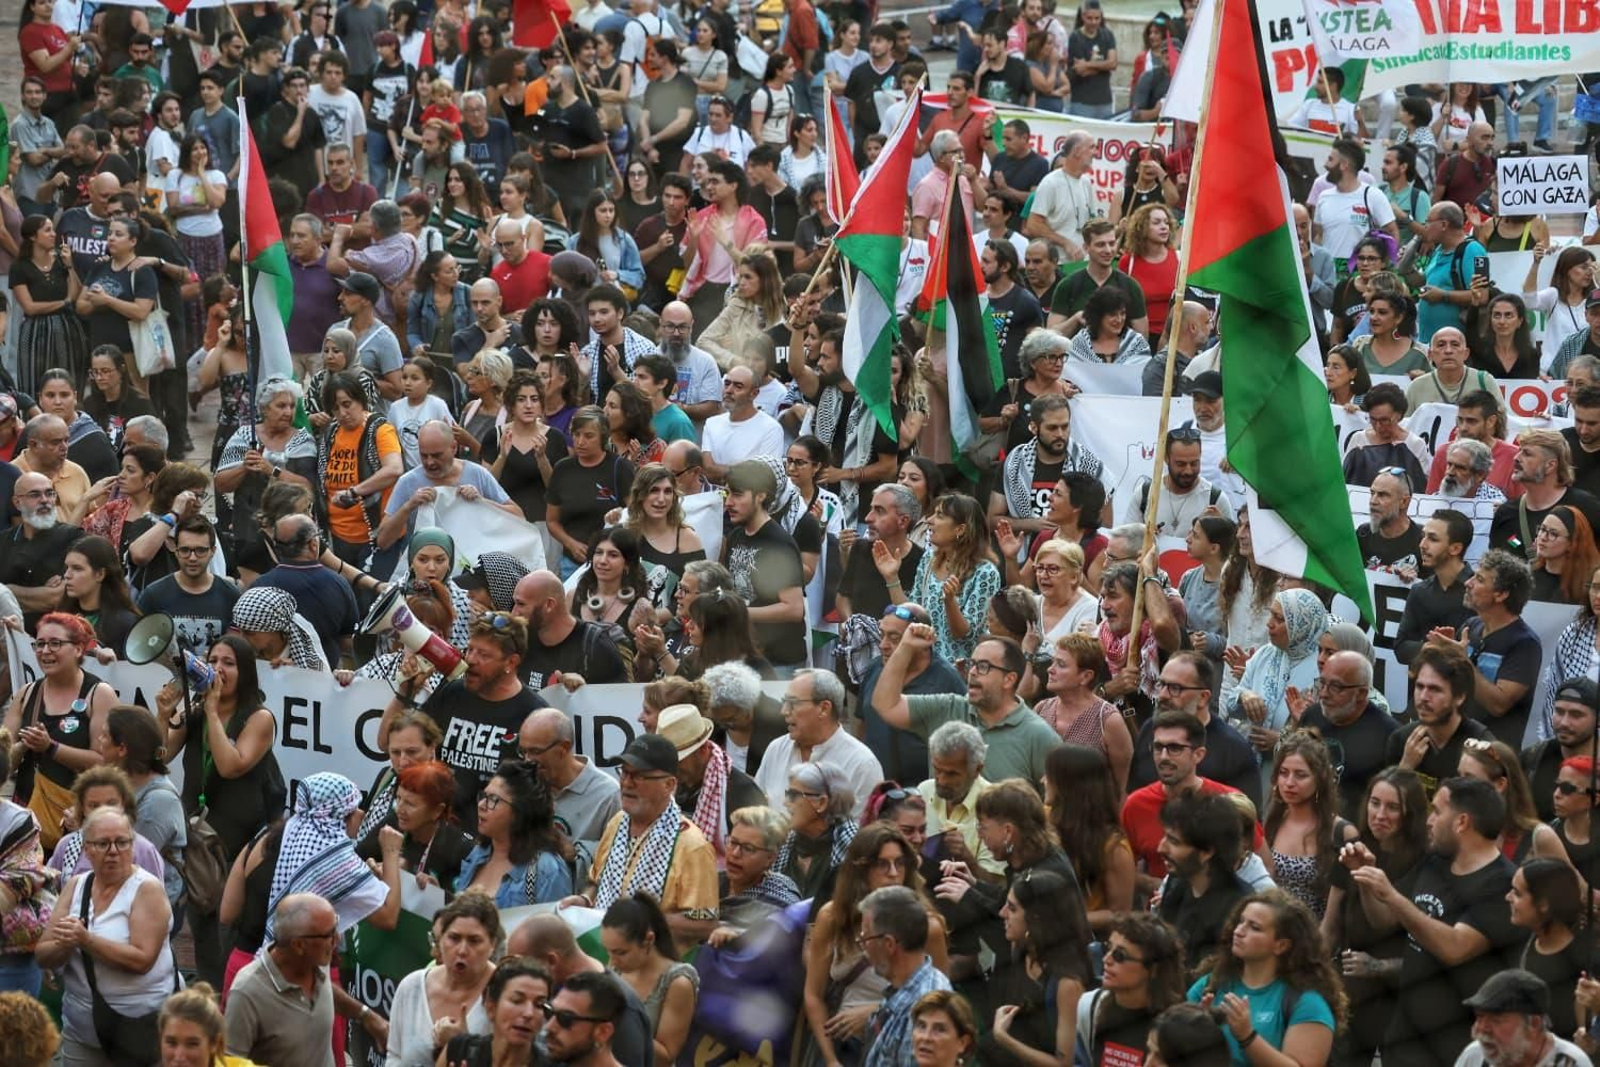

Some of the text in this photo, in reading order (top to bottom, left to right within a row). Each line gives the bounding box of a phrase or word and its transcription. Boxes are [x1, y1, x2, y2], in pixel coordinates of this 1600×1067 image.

[1269, 17, 1294, 42] LA
[1503, 159, 1582, 184] MÁLAGA
[1502, 186, 1586, 206] CON GAZA
[67, 237, 108, 255] PALEST
[341, 461, 356, 471] DU
[443, 716, 507, 758] FREE
[441, 747, 500, 774] PALESTINE
